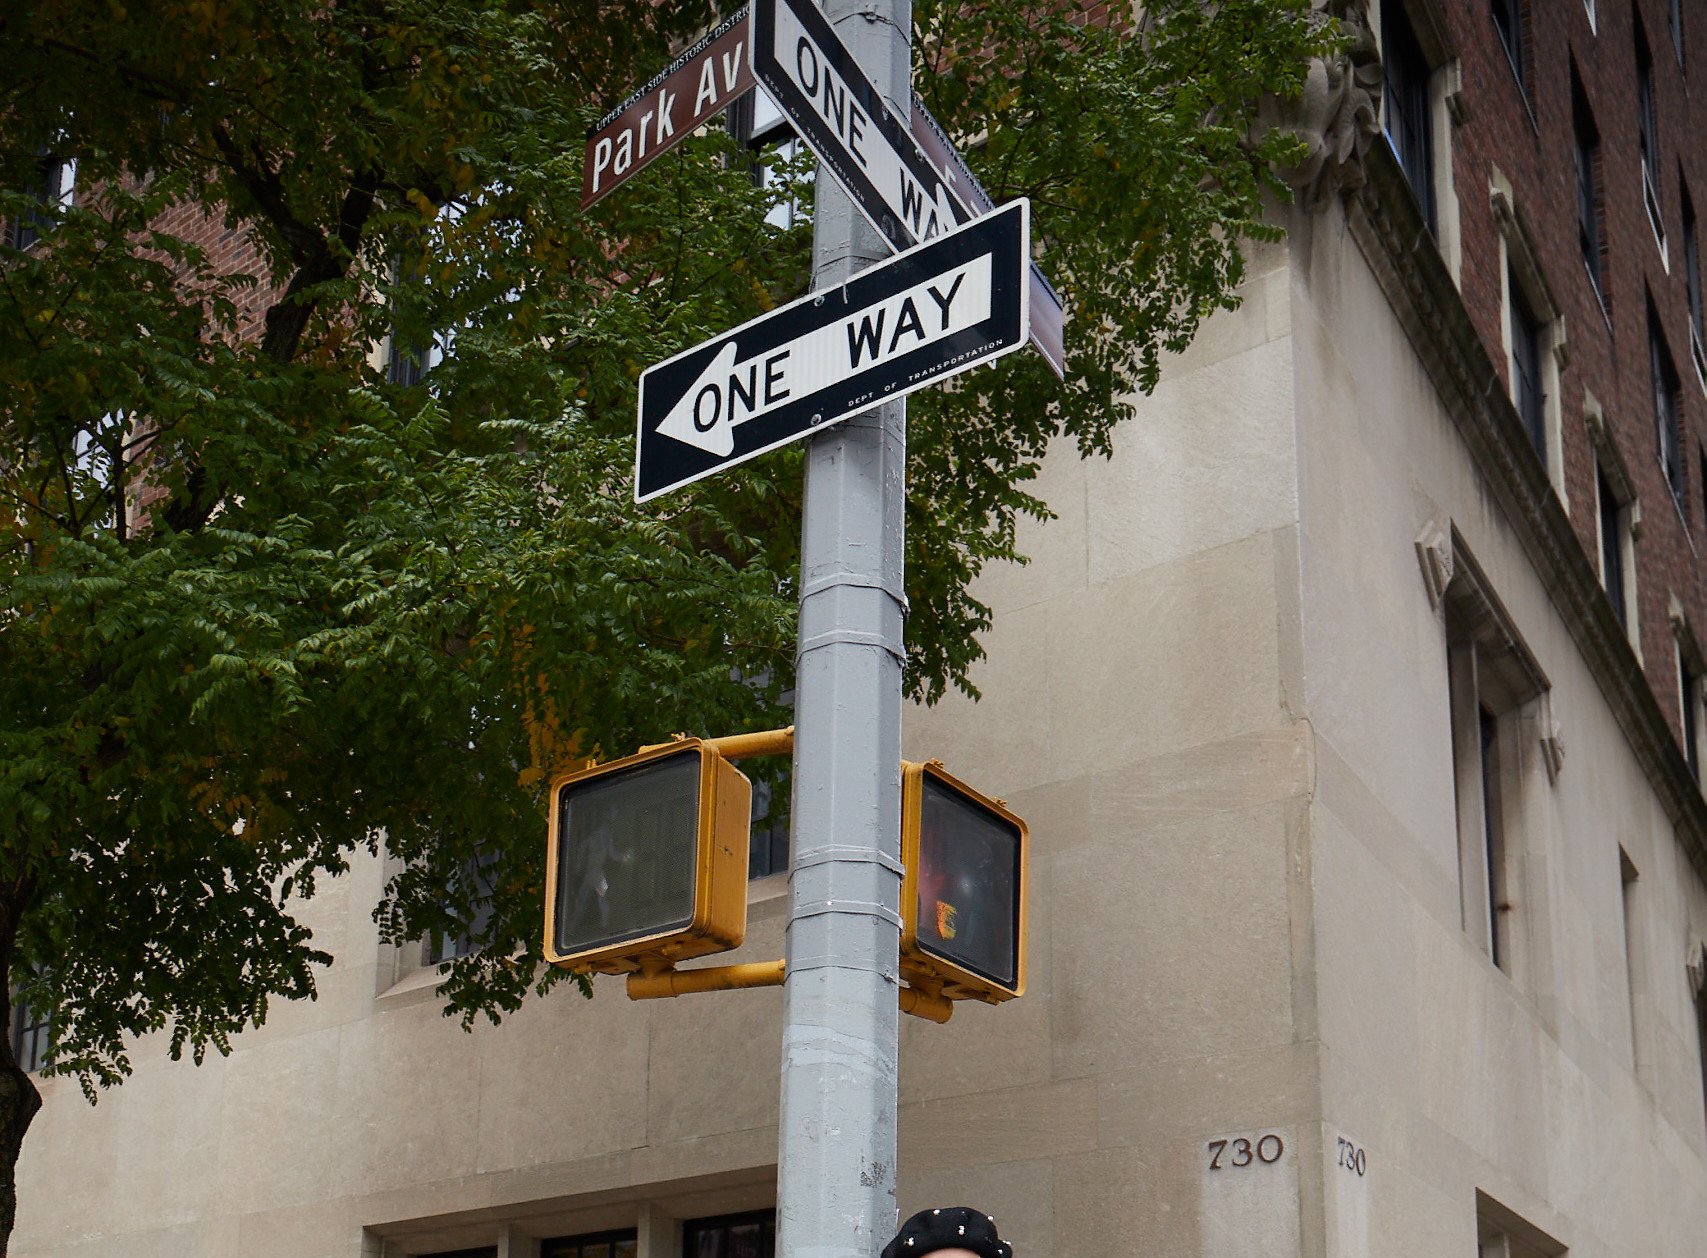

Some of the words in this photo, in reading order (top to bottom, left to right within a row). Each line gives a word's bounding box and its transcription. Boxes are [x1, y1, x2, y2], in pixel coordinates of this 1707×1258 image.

[592, 88, 676, 194] Park
[694, 41, 743, 118] Av
[596, 105, 623, 131] UPPER
[624, 85, 647, 109] EAST
[647, 67, 669, 91] SIDE
[669, 33, 713, 75] HISTORIC
[714, 4, 750, 38] DISTRIC
[796, 35, 867, 169] ONE
[899, 165, 948, 243] WA
[693, 350, 791, 433] ONE
[847, 272, 966, 369] WAY
[848, 391, 873, 407] DEPT
[884, 381, 897, 392] OF
[907, 338, 1003, 382] TRANSPORTATION
[1208, 1134, 1284, 1170] 730
[1337, 1136, 1366, 1177] 730
